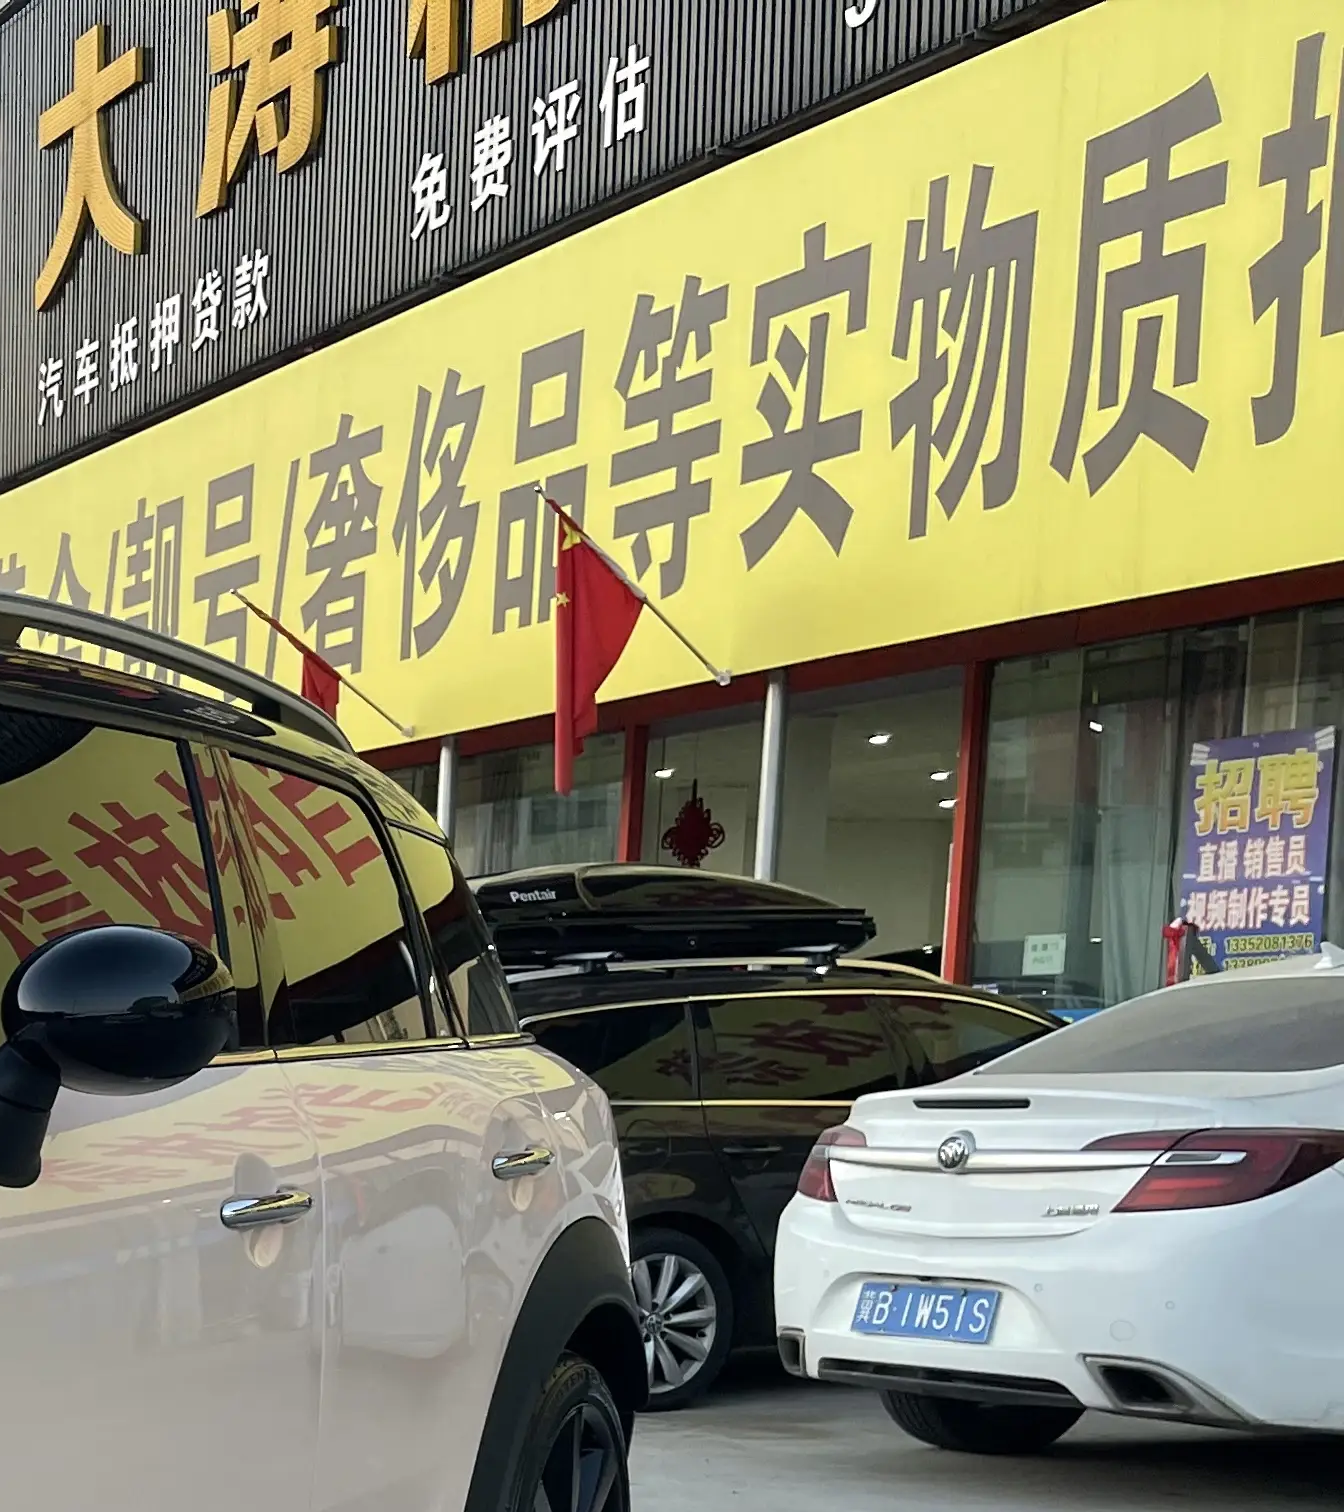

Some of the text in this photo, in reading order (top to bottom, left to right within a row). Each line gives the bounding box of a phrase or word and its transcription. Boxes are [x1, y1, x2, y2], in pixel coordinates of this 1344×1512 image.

[409, 44, 652, 241] 免费评估
[37, 248, 271, 427] 汽车抵押贷款
[1193, 748, 1320, 837] 招聘
[1196, 834, 1311, 883] 直播 销售员
[509, 888, 557, 903] Pentair
[1185, 885, 1311, 932] 视频制作专员
